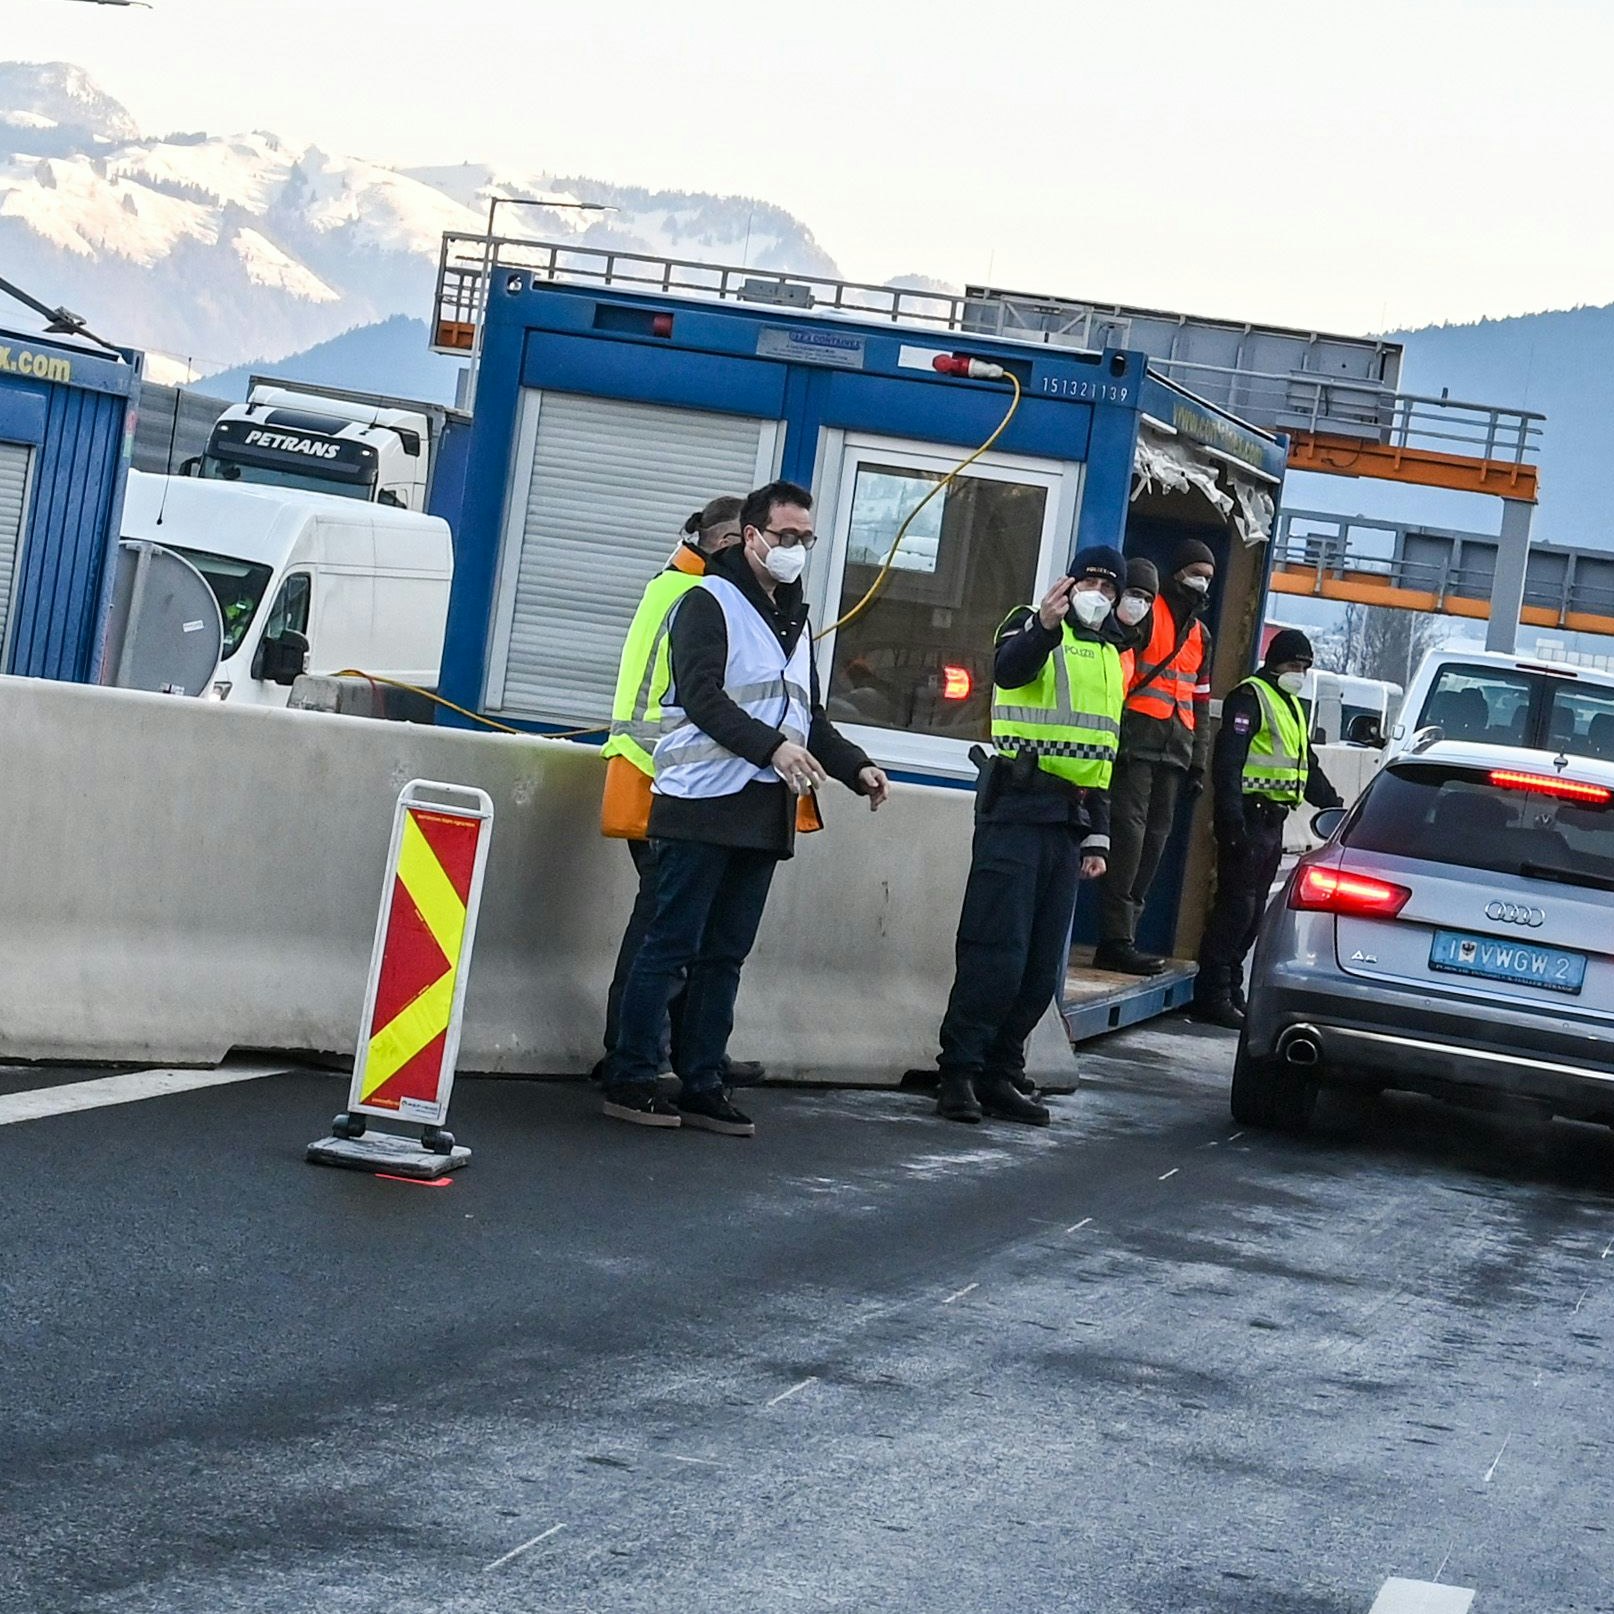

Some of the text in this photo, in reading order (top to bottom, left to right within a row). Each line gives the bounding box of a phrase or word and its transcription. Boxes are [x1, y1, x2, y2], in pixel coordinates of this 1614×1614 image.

[1043, 377, 1128, 402] 151321139
[244, 430, 341, 459] PETRANS
[1481, 944, 1549, 974] VWGW
[1555, 957, 1570, 979] 2
